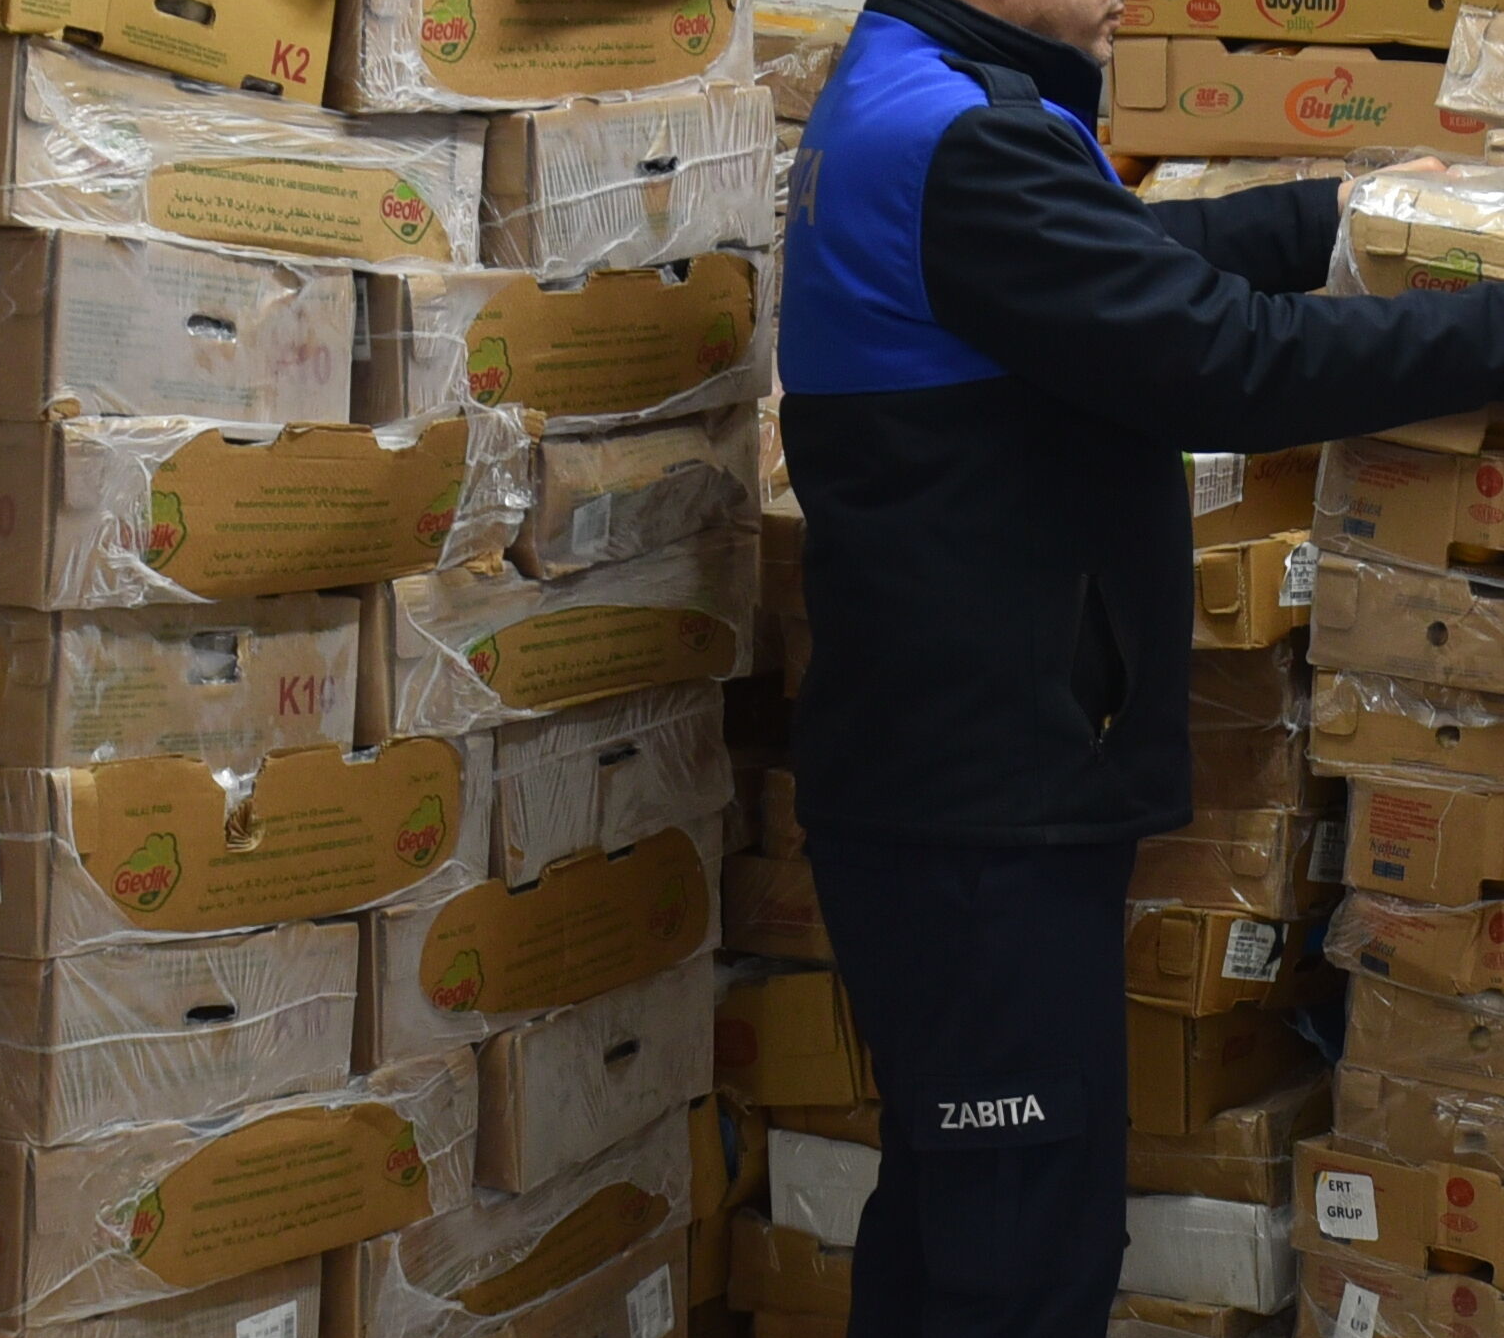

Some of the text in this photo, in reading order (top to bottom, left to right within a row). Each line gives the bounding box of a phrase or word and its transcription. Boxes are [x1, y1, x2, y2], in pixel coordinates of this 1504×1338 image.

[421, 18, 470, 42] Gedik
[673, 13, 711, 39] Gedik
[270, 40, 312, 85] K2
[1299, 95, 1388, 128] Bupiliç
[382, 195, 425, 221] Gedik
[278, 675, 335, 717] K10
[398, 826, 443, 854] Gedik
[115, 864, 172, 897] Gedik
[938, 1094, 1046, 1130] ZABITA
[1327, 1179, 1352, 1194] ERT
[1326, 1204, 1363, 1222] GRUP
[1350, 1319, 1369, 1334] UP
